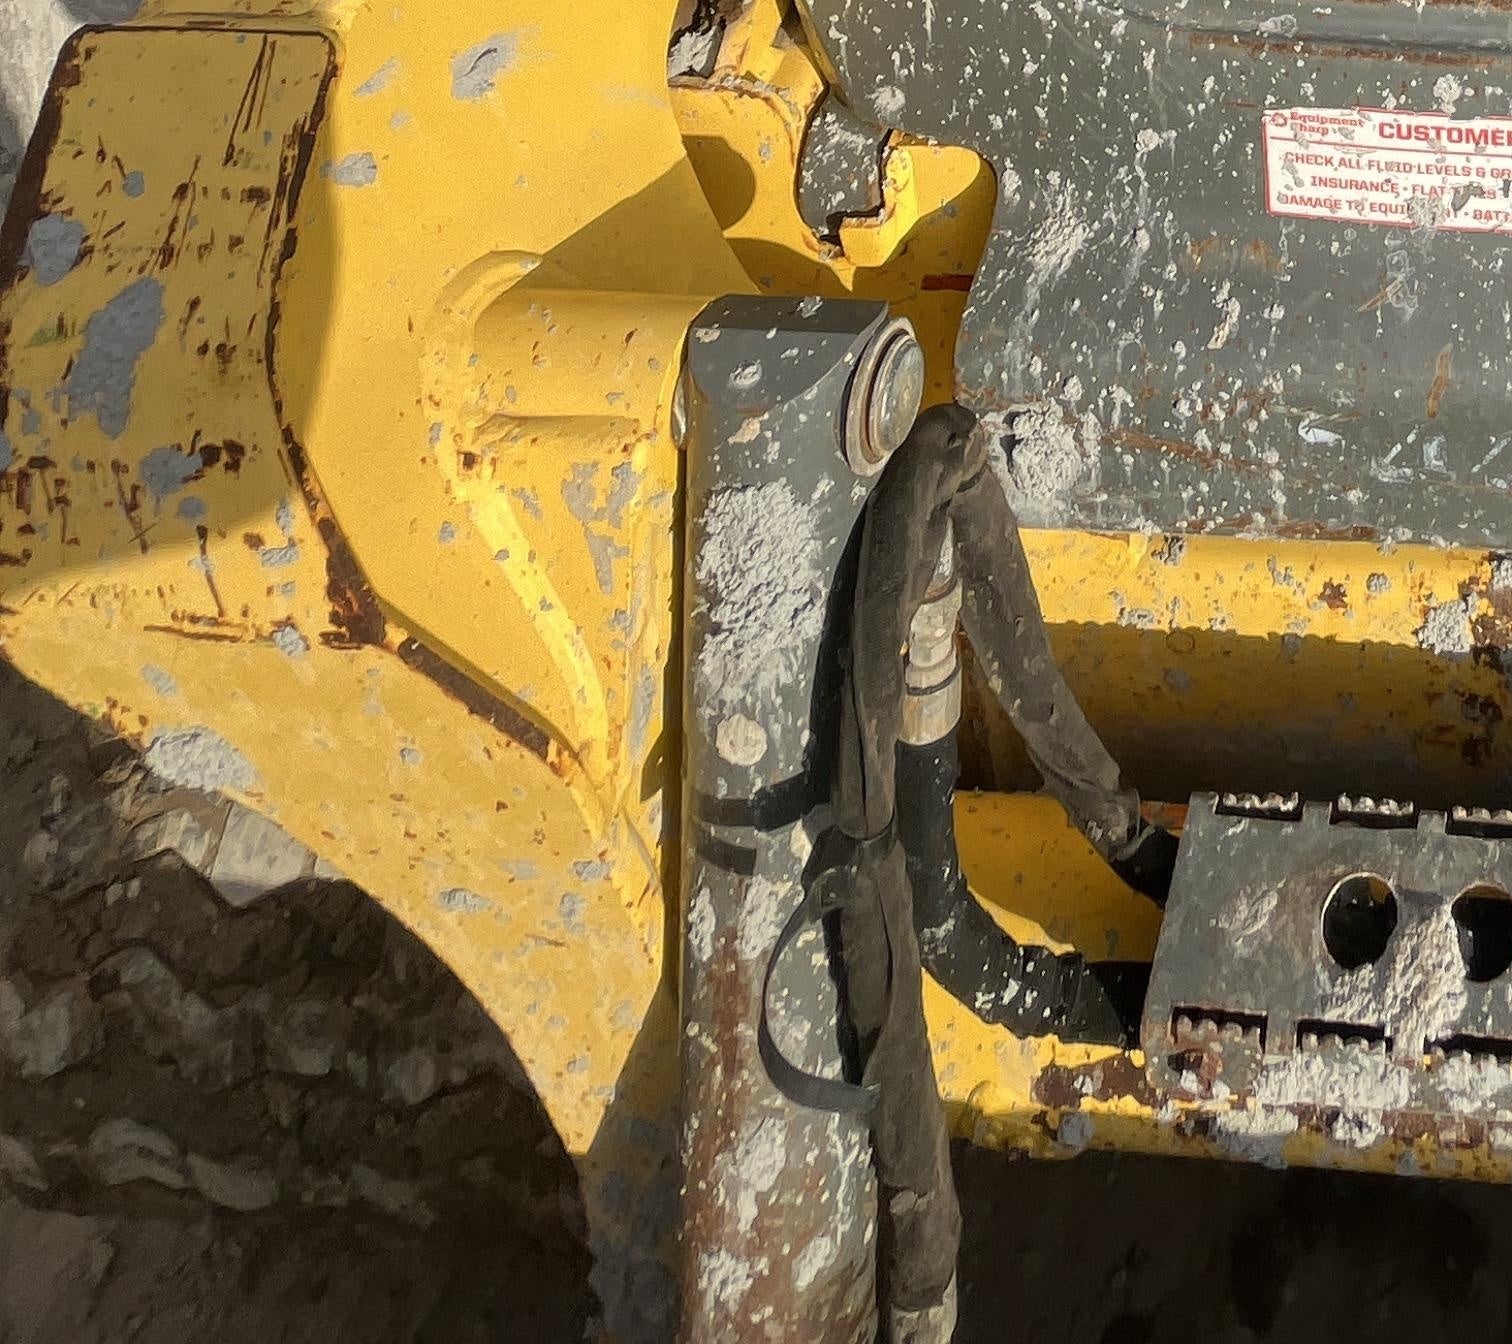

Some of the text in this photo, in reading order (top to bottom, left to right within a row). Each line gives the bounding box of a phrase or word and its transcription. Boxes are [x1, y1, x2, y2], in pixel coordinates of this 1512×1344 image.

[1290, 112, 1365, 128] Equipment
[1284, 151, 1334, 167] CHECK
[1338, 157, 1362, 170] ALL
[1367, 160, 1412, 173] FLUID
[1417, 164, 1471, 177] LEVELS
[1310, 176, 1400, 192] INSURANCE
[1411, 184, 1445, 199] FLAT
[1279, 194, 1342, 210] DAMAGE
[1369, 202, 1458, 218] EQUINT
